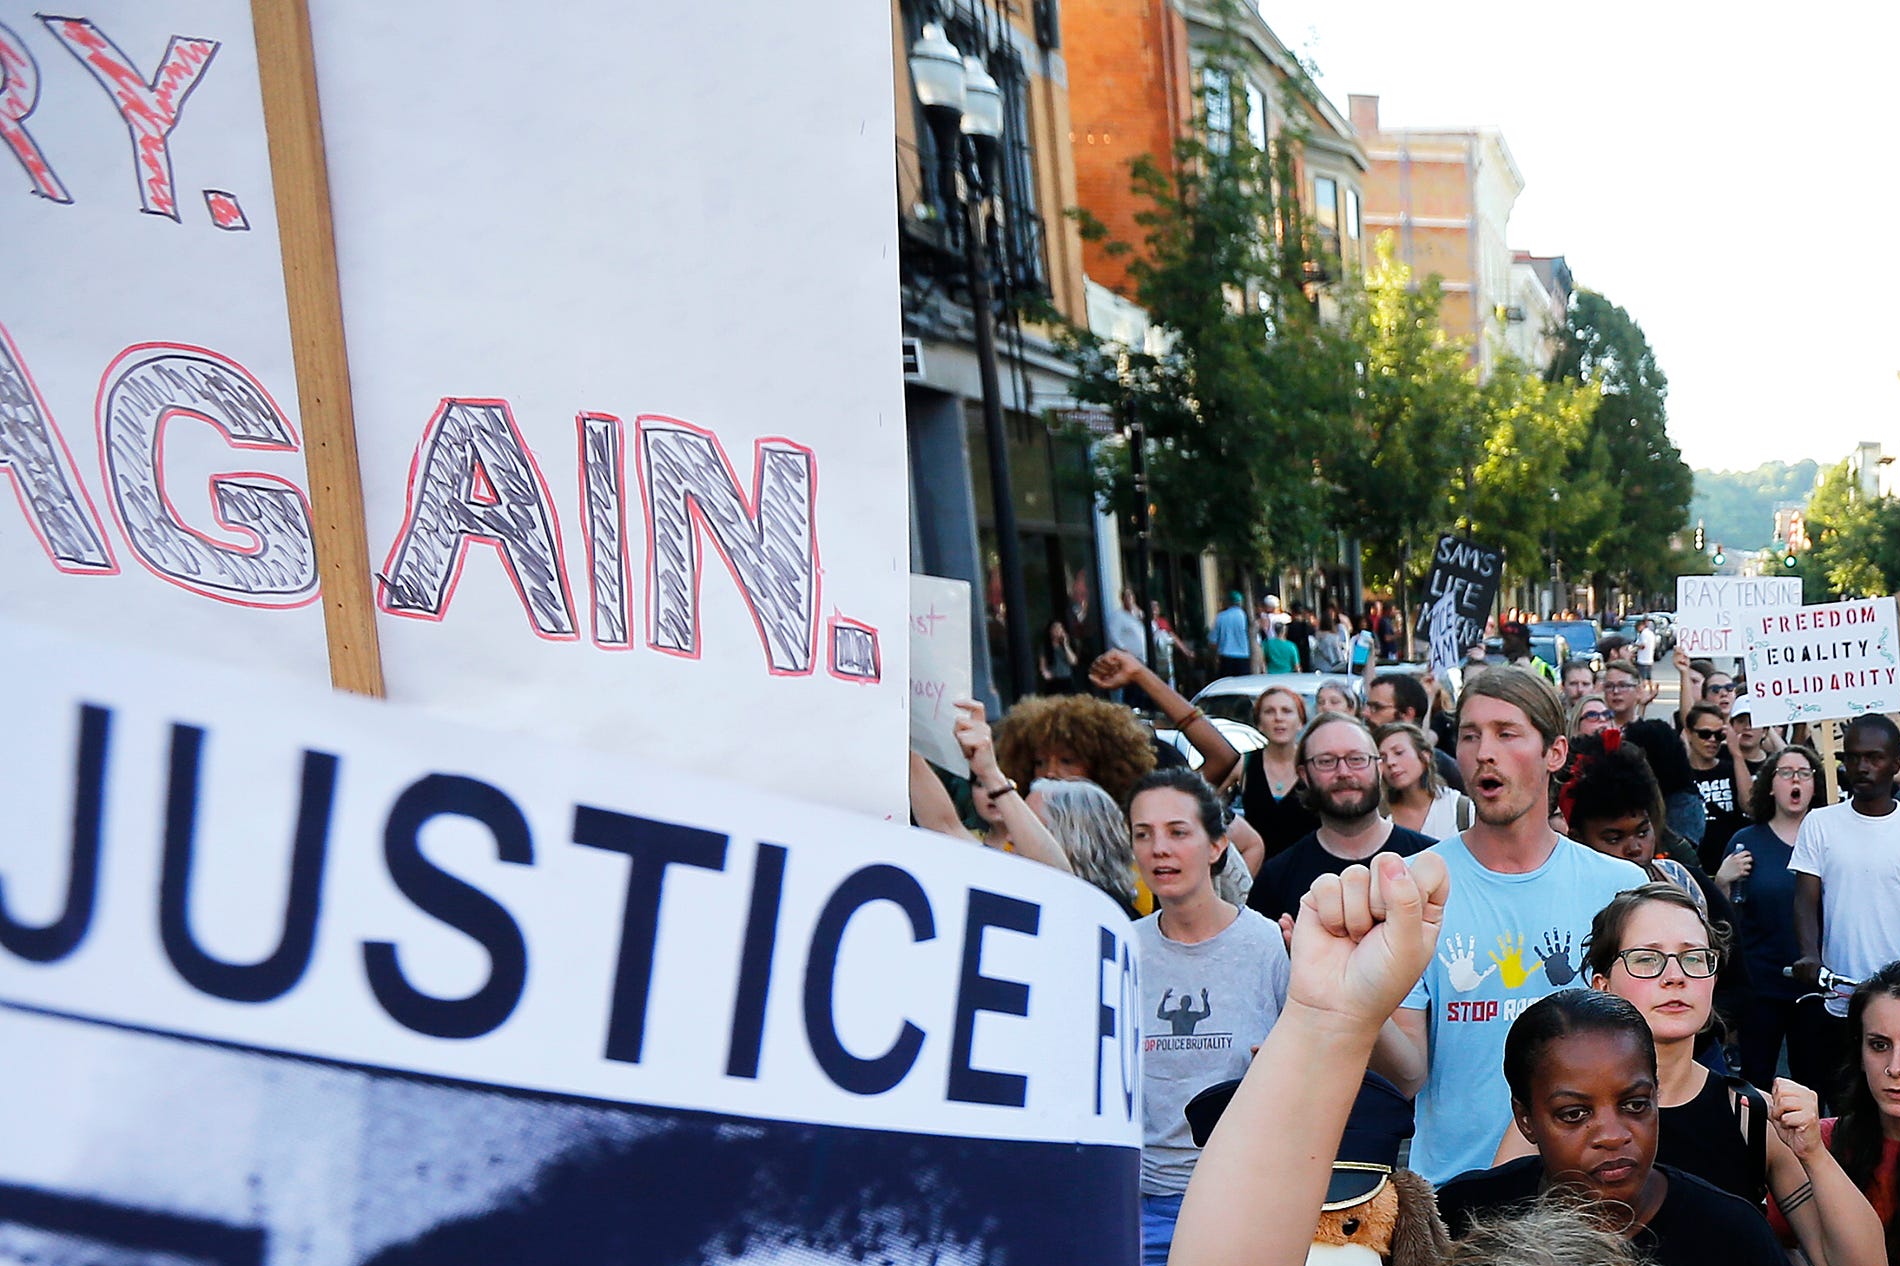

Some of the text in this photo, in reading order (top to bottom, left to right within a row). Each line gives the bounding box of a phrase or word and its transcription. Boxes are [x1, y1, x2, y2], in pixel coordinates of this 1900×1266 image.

[1436, 535, 1497, 578] SAM'S
[1430, 568, 1484, 609] LIFE
[1683, 579, 1730, 608] RAY
[1716, 610, 1731, 626] IS
[1761, 605, 1876, 635] FREEDOM
[1678, 628, 1733, 653] RACIST
[1766, 639, 1870, 666] EQALITY
[1755, 667, 1896, 698] SOLIDARITY
[0, 702, 1041, 1108] JUSTICE
[1447, 1000, 1498, 1022] STOP
[1144, 1036, 1233, 1052] OP POLICE BRUTALITY
